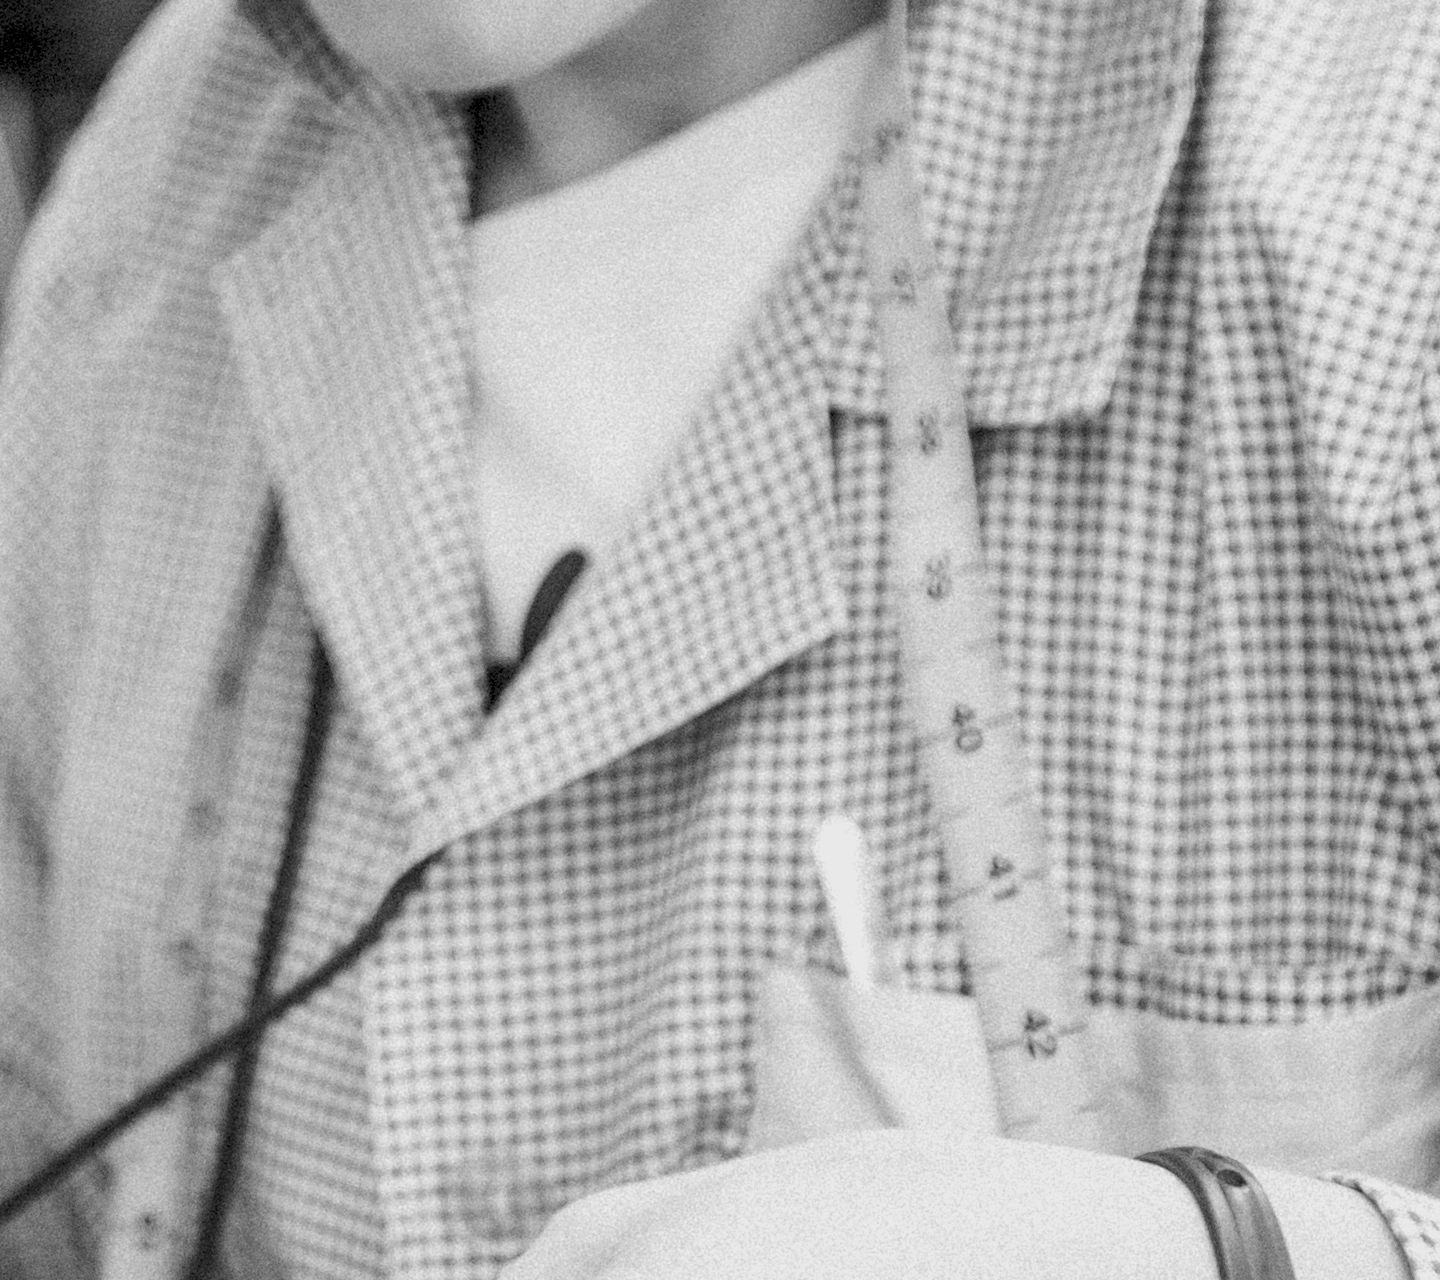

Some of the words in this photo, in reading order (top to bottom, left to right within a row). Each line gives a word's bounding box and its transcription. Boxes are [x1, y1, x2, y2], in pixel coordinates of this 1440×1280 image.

[952, 703, 984, 754] 40
[989, 853, 1019, 902] 41
[1023, 1009, 1058, 1061] 42
